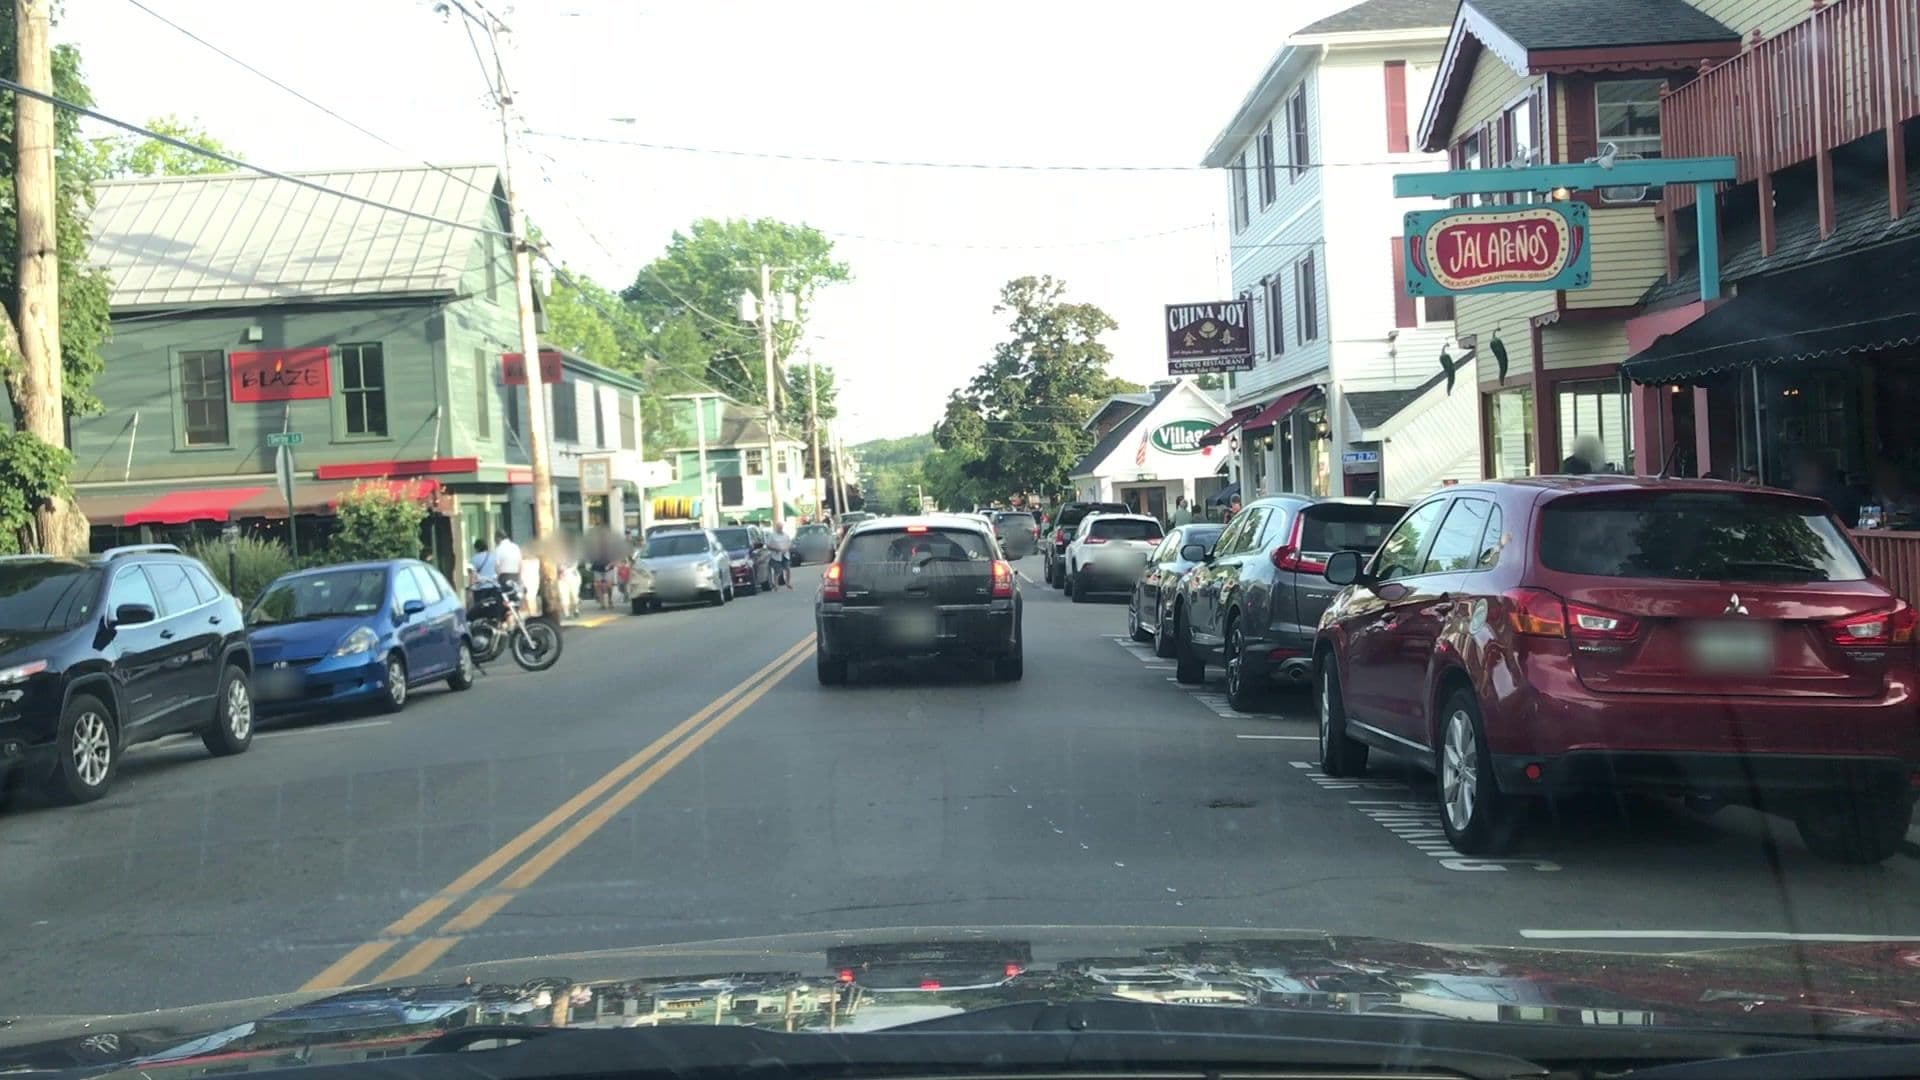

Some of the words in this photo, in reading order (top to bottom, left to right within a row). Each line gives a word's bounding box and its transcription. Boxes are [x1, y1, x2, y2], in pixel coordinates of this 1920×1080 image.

[1443, 277, 1481, 287] MEXICAN
[1482, 273, 1517, 282] CANTINA
[1527, 271, 1555, 279] GRILL
[1169, 306, 1215, 332] CHINA
[1217, 303, 1246, 328] JOY
[1174, 361, 1201, 369] CHINESE
[1202, 359, 1245, 367] RESTAURANT
